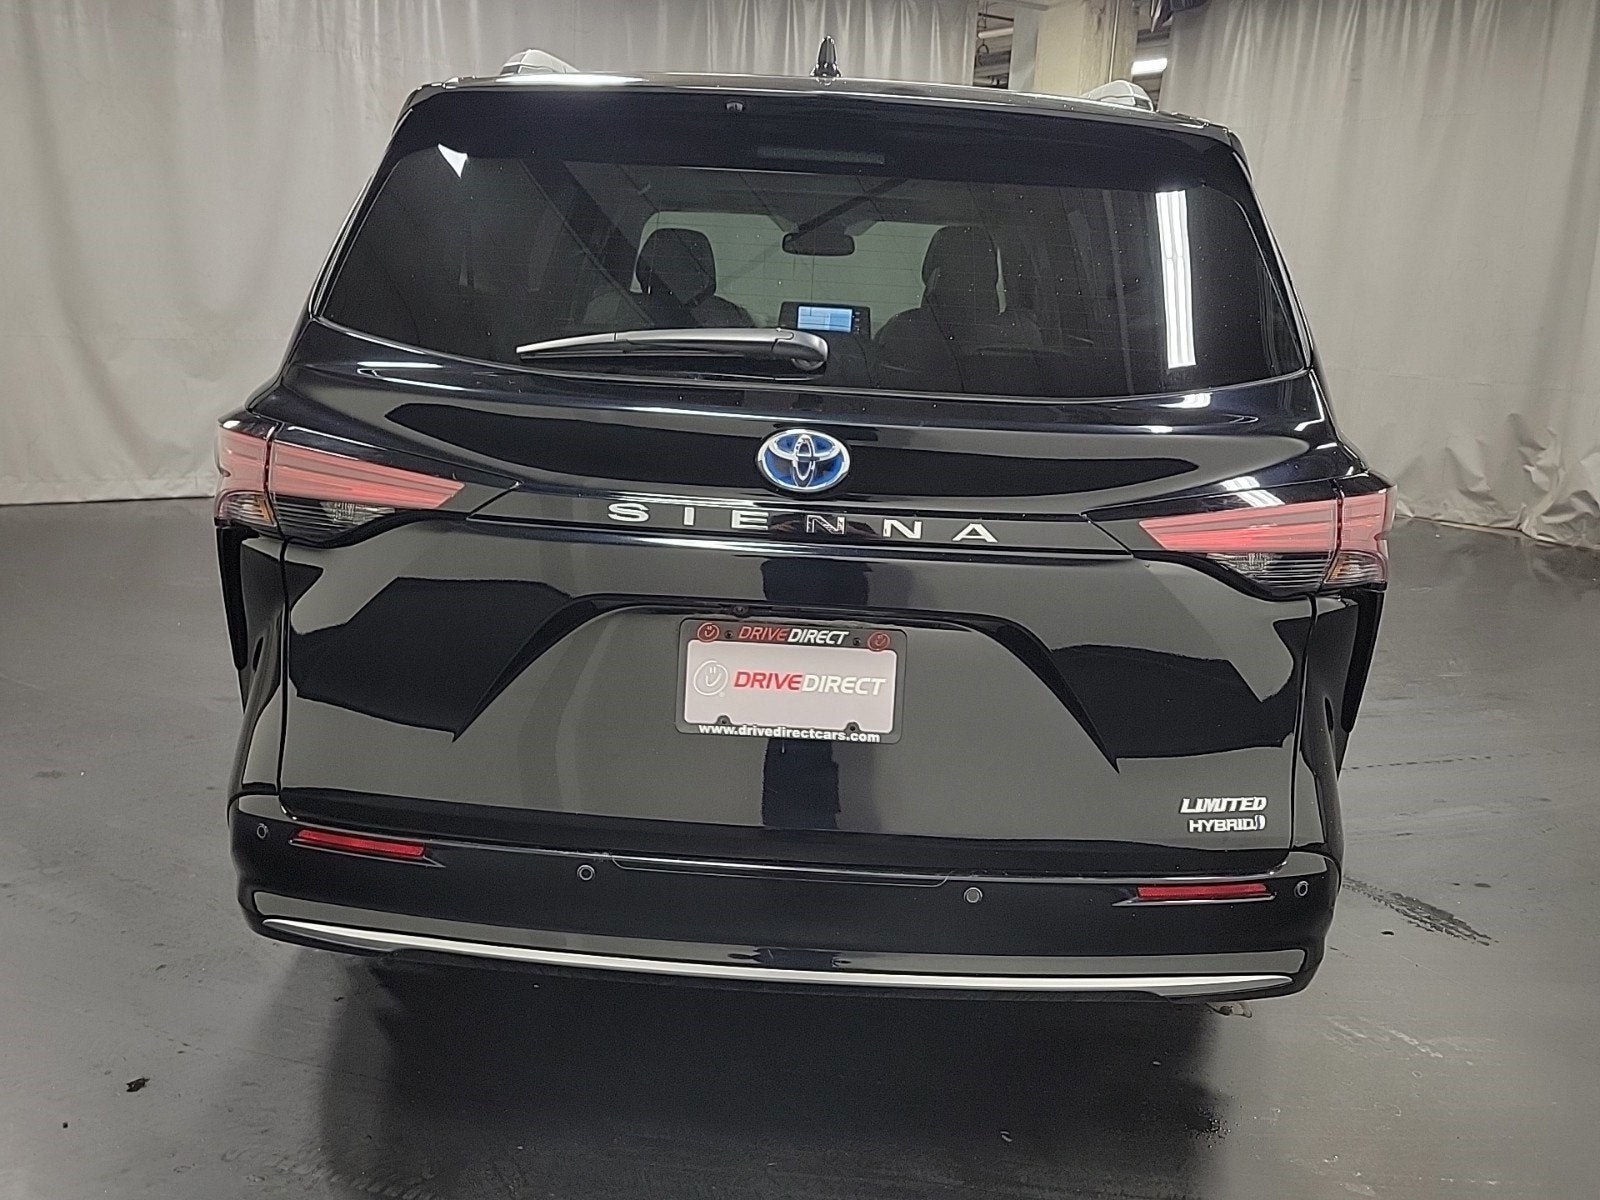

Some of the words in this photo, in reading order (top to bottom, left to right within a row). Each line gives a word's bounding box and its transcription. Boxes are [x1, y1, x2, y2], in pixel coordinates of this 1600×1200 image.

[607, 502, 999, 544] SIENNA
[699, 724, 881, 743] www.drivedirectcars.com
[1180, 796, 1268, 814] LIMITED
[1188, 818, 1256, 832] HYBRID
